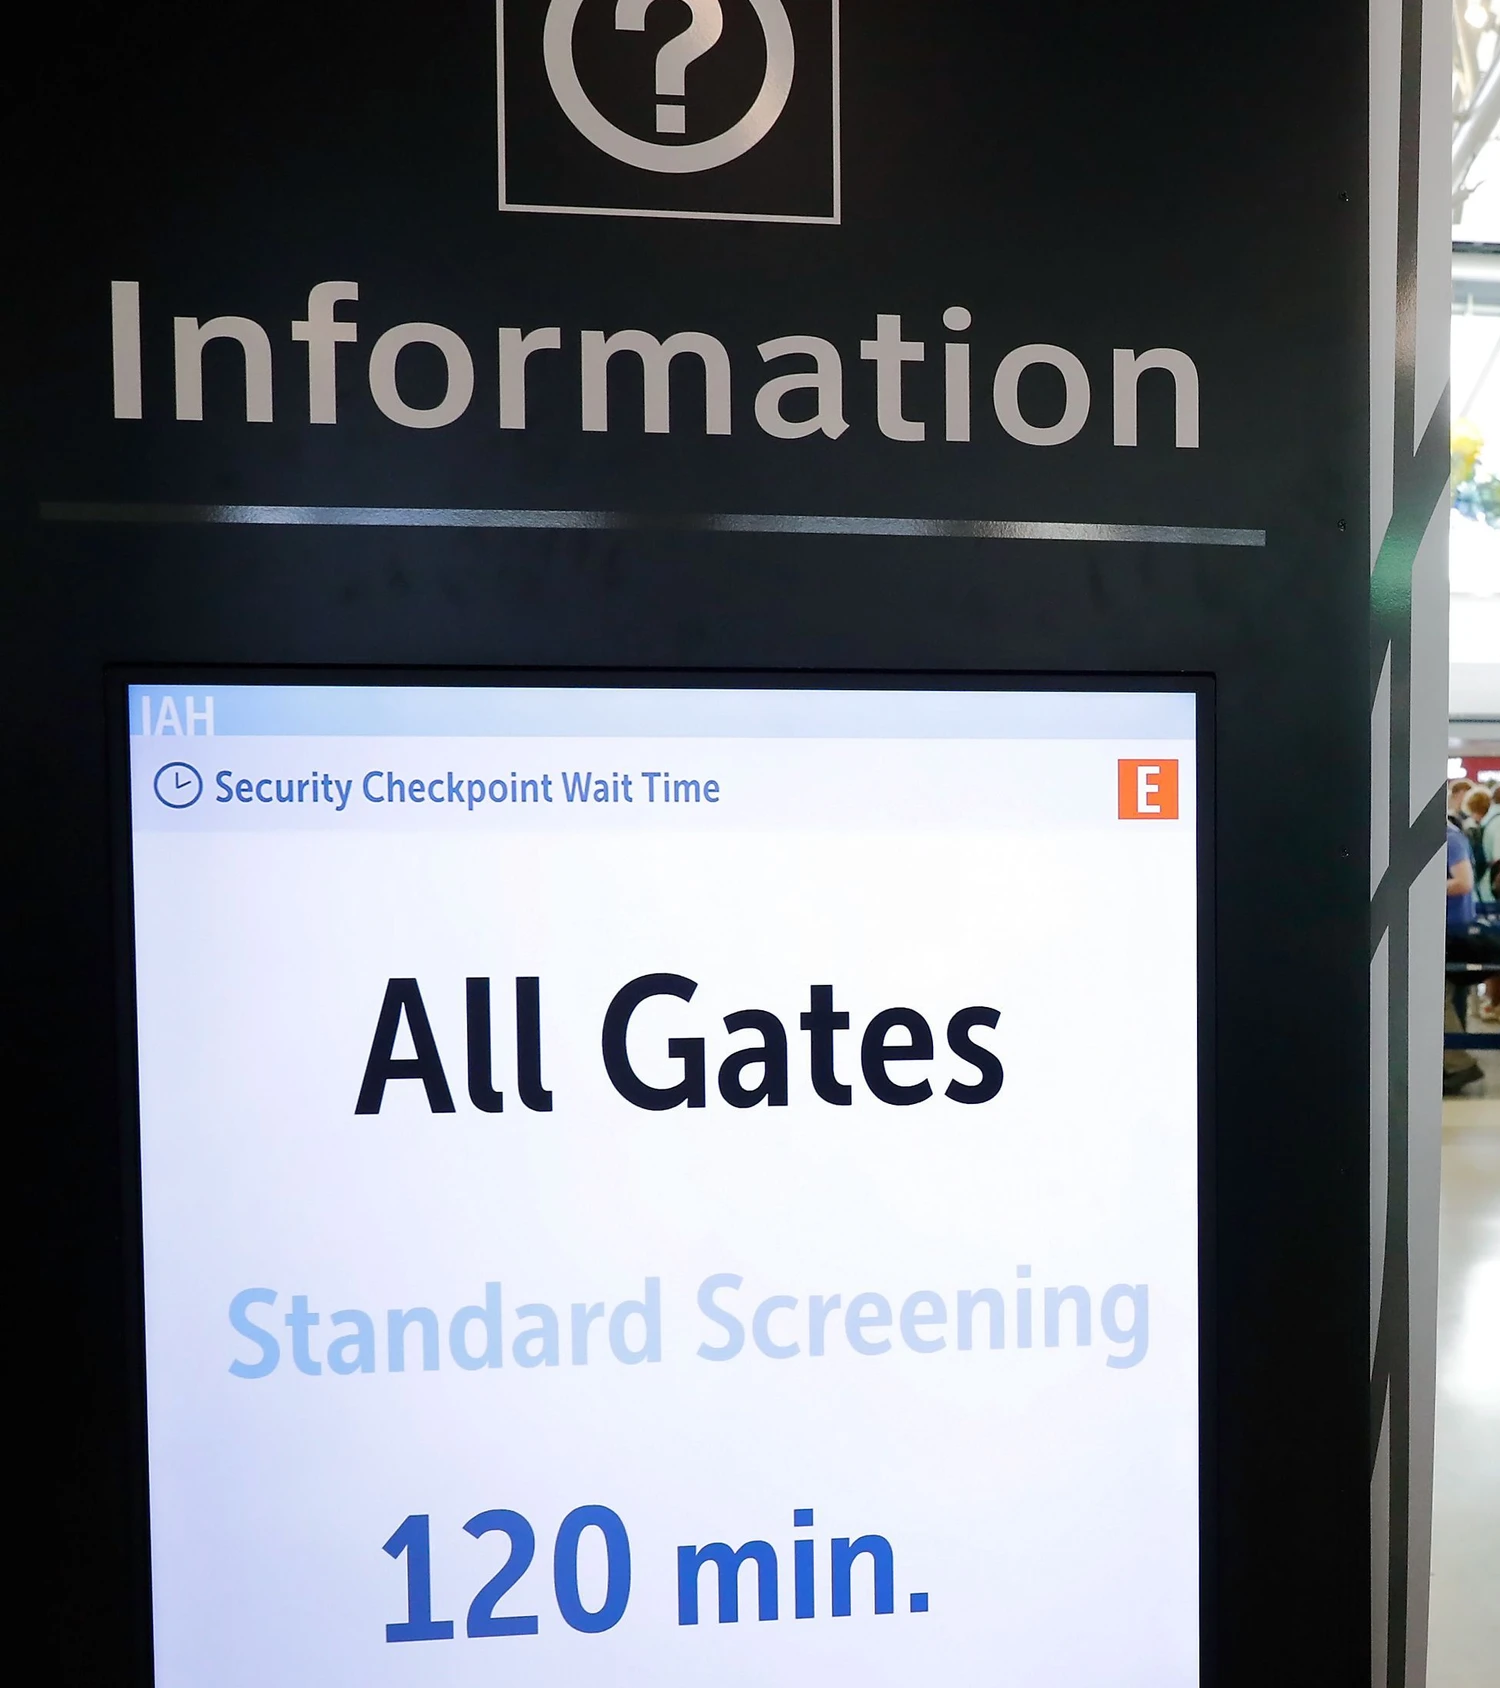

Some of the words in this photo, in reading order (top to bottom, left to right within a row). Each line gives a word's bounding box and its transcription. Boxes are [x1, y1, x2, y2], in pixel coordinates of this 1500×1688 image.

[111, 281, 1200, 449] Information
[142, 696, 214, 736] IAH
[215, 769, 353, 812] Security
[362, 770, 553, 812] Checkpoint
[561, 771, 634, 803] Wait
[641, 771, 721, 803] Time
[1136, 765, 1161, 813] E
[355, 976, 553, 1115] All
[601, 972, 1004, 1112] Gates
[228, 1276, 662, 1380] Standard
[696, 1265, 1150, 1370] Screening
[382, 1504, 632, 1645] 120
[677, 1508, 929, 1626] min.
